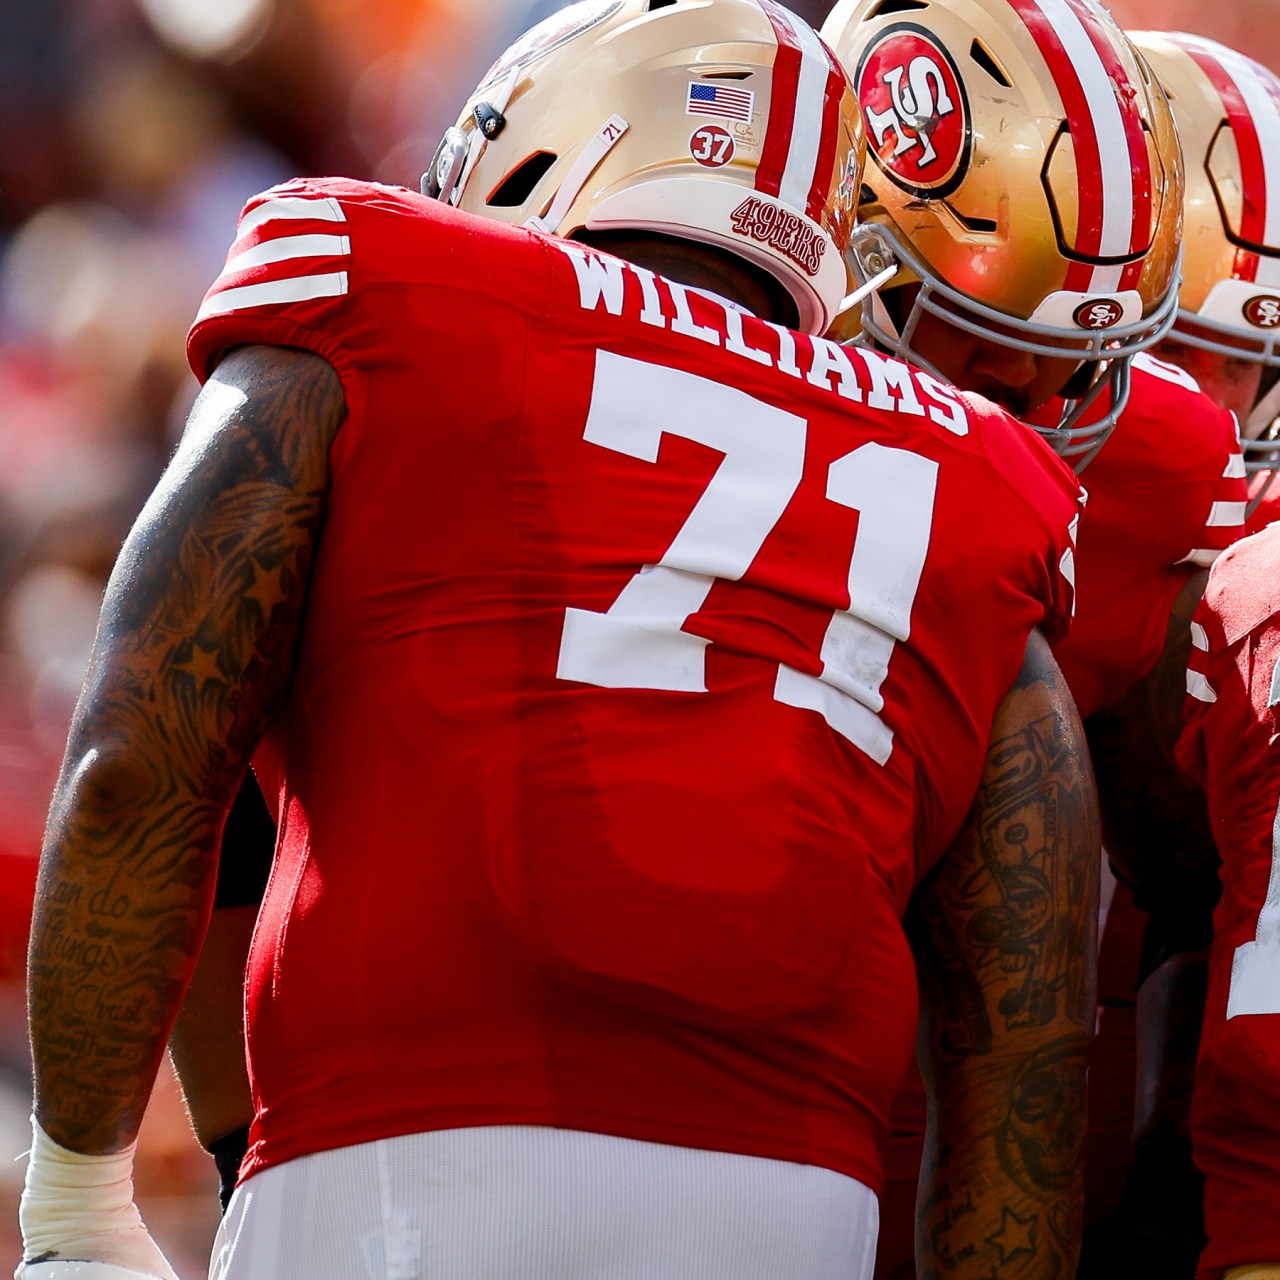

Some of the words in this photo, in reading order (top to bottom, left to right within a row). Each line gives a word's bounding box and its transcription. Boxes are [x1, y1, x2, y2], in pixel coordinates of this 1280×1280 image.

[602, 123, 622, 142] 71
[693, 131, 732, 164] 37
[866, 55, 955, 168] SF
[730, 196, 828, 277] 49ERS
[559, 244, 970, 437] WILLIAMS
[1088, 303, 1116, 328] SF
[556, 347, 939, 767] 71
